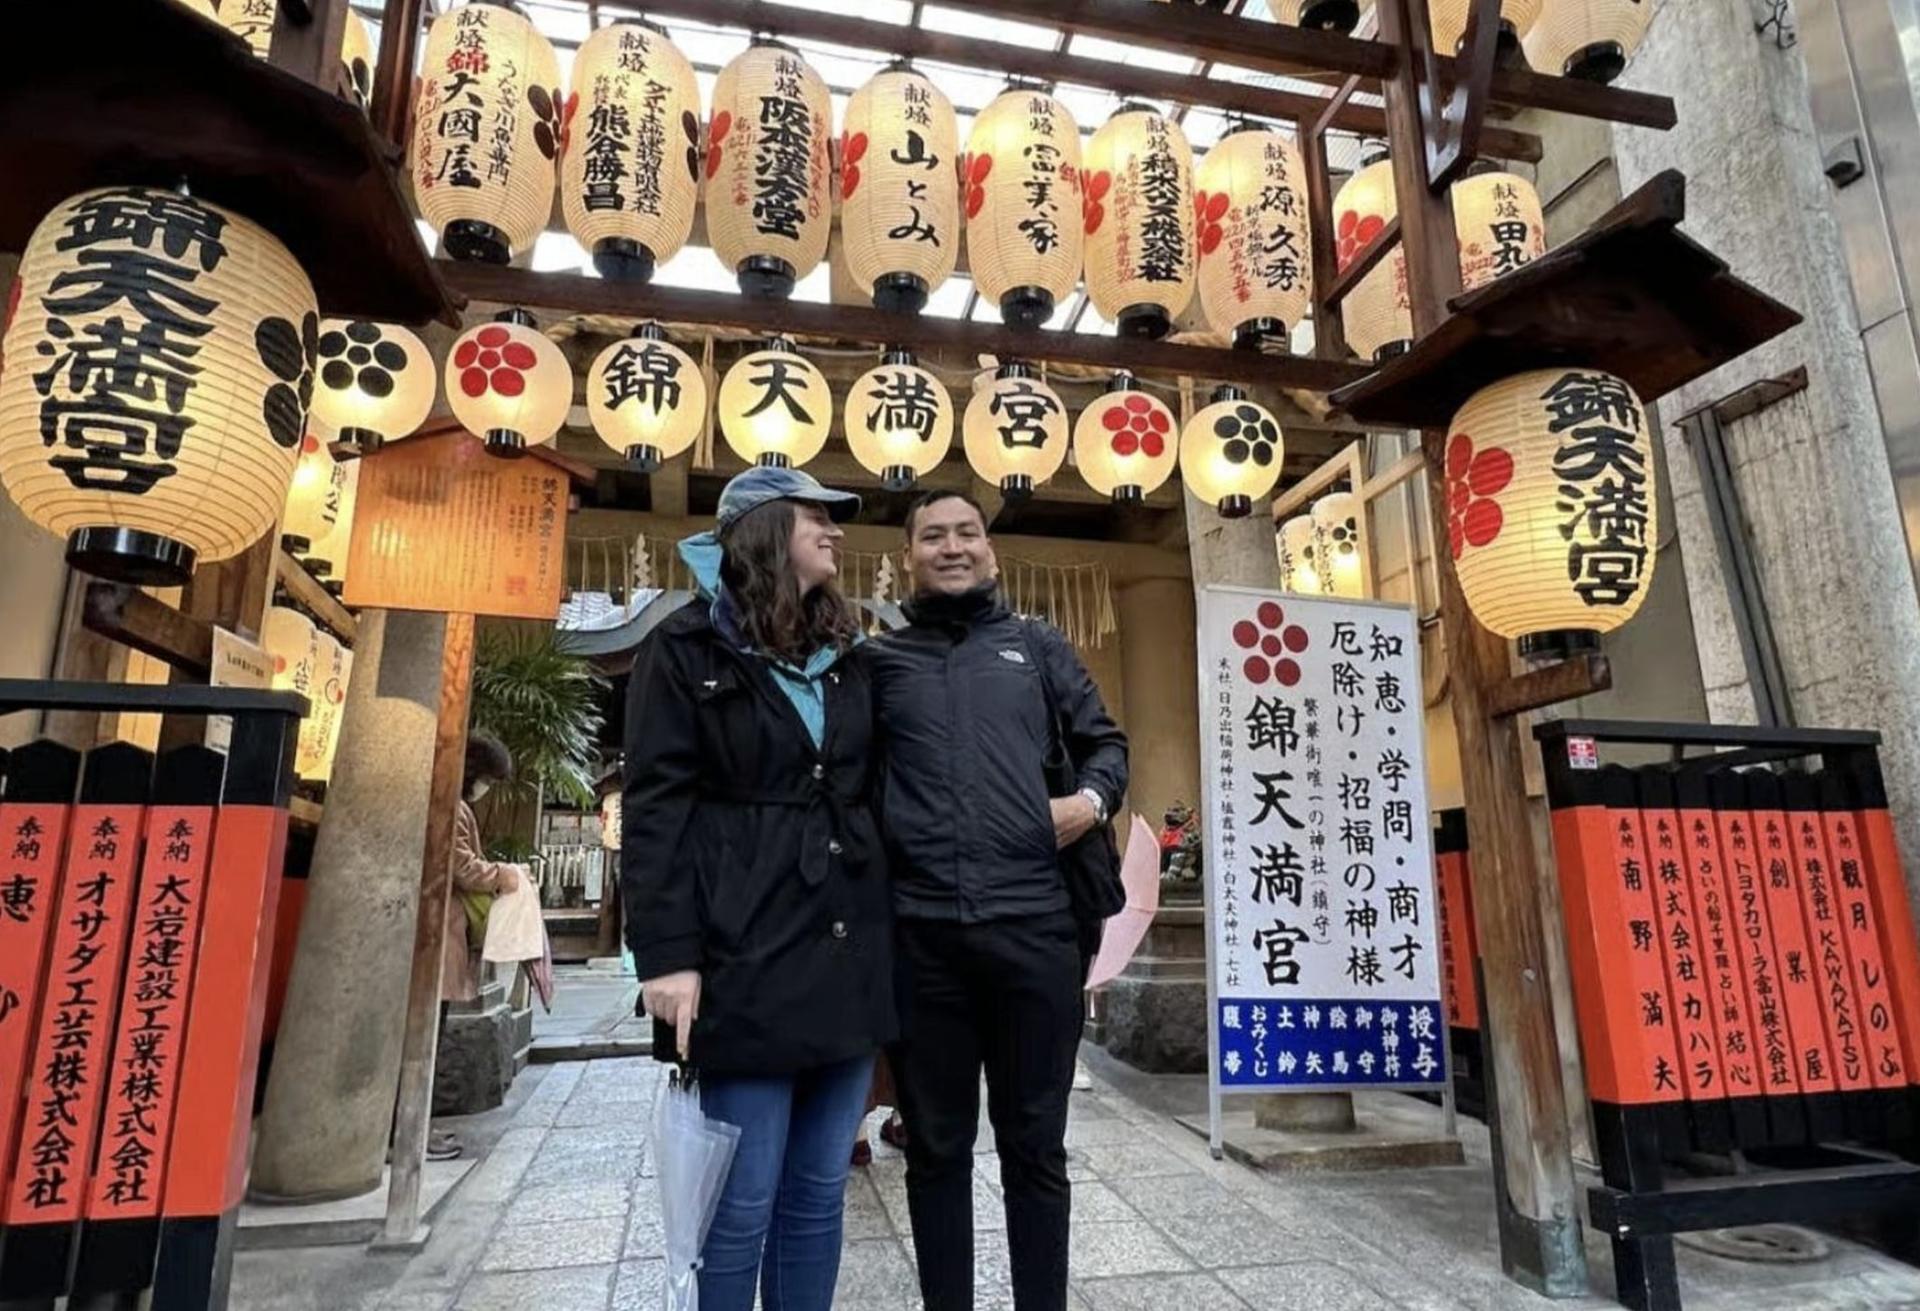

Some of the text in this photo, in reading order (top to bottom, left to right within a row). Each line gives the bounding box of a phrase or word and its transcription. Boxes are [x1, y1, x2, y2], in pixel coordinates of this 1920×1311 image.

[455, 8, 489, 50] 献燈
[618, 31, 651, 77] 献燈
[446, 49, 491, 75] 錦
[775, 56, 804, 99] 献燈
[904, 83, 932, 128] 献燈
[1029, 98, 1055, 138] 献燈
[1146, 117, 1171, 152] 献燈
[888, 130, 940, 247] 山とみ
[1264, 142, 1288, 181] 献燈
[1493, 183, 1519, 218] 献燈
[1260, 185, 1299, 291] 源久秀
[1489, 221, 1531, 277] 田丸
[32, 186, 229, 495] 錦天満宮
[602, 345, 1059, 450] 錦 天 満 宮
[1539, 372, 1649, 607] 錦天満宮
[1330, 621, 1385, 987] 厄除け・招福の神様
[1369, 623, 1423, 981] 知恵・学問・商才
[1618, 817, 1635, 849] 奉納
[11, 816, 43, 861] 奉納
[89, 816, 119, 861] 奉納
[163, 818, 194, 863] 奉納
[1244, 695, 1310, 986] 錦天満宮
[1655, 818, 1672, 849] 奉納
[1693, 818, 1710, 849] 奉納
[1730, 819, 1746, 850] 奉納
[1766, 820, 1781, 850] 奉納
[1801, 820, 1817, 850] 奉納
[1658, 858, 1713, 1090] 株式会社カハラ
[1819, 929, 1861, 1081] KAWAKATSU
[26, 872, 115, 1210] オサダ工芸株式会社
[102, 874, 191, 1206] 大岩建設工業株式会社
[1251, 1005, 1268, 1077] おみくじ
[1277, 1005, 1297, 1074] 土鈴
[1304, 1005, 1324, 1074] 神矢
[1329, 1005, 1349, 1074] 絵馬
[1355, 1006, 1375, 1074] 御守
[1380, 1006, 1400, 1078] 御神符
[1408, 1005, 1438, 1078] 授与
